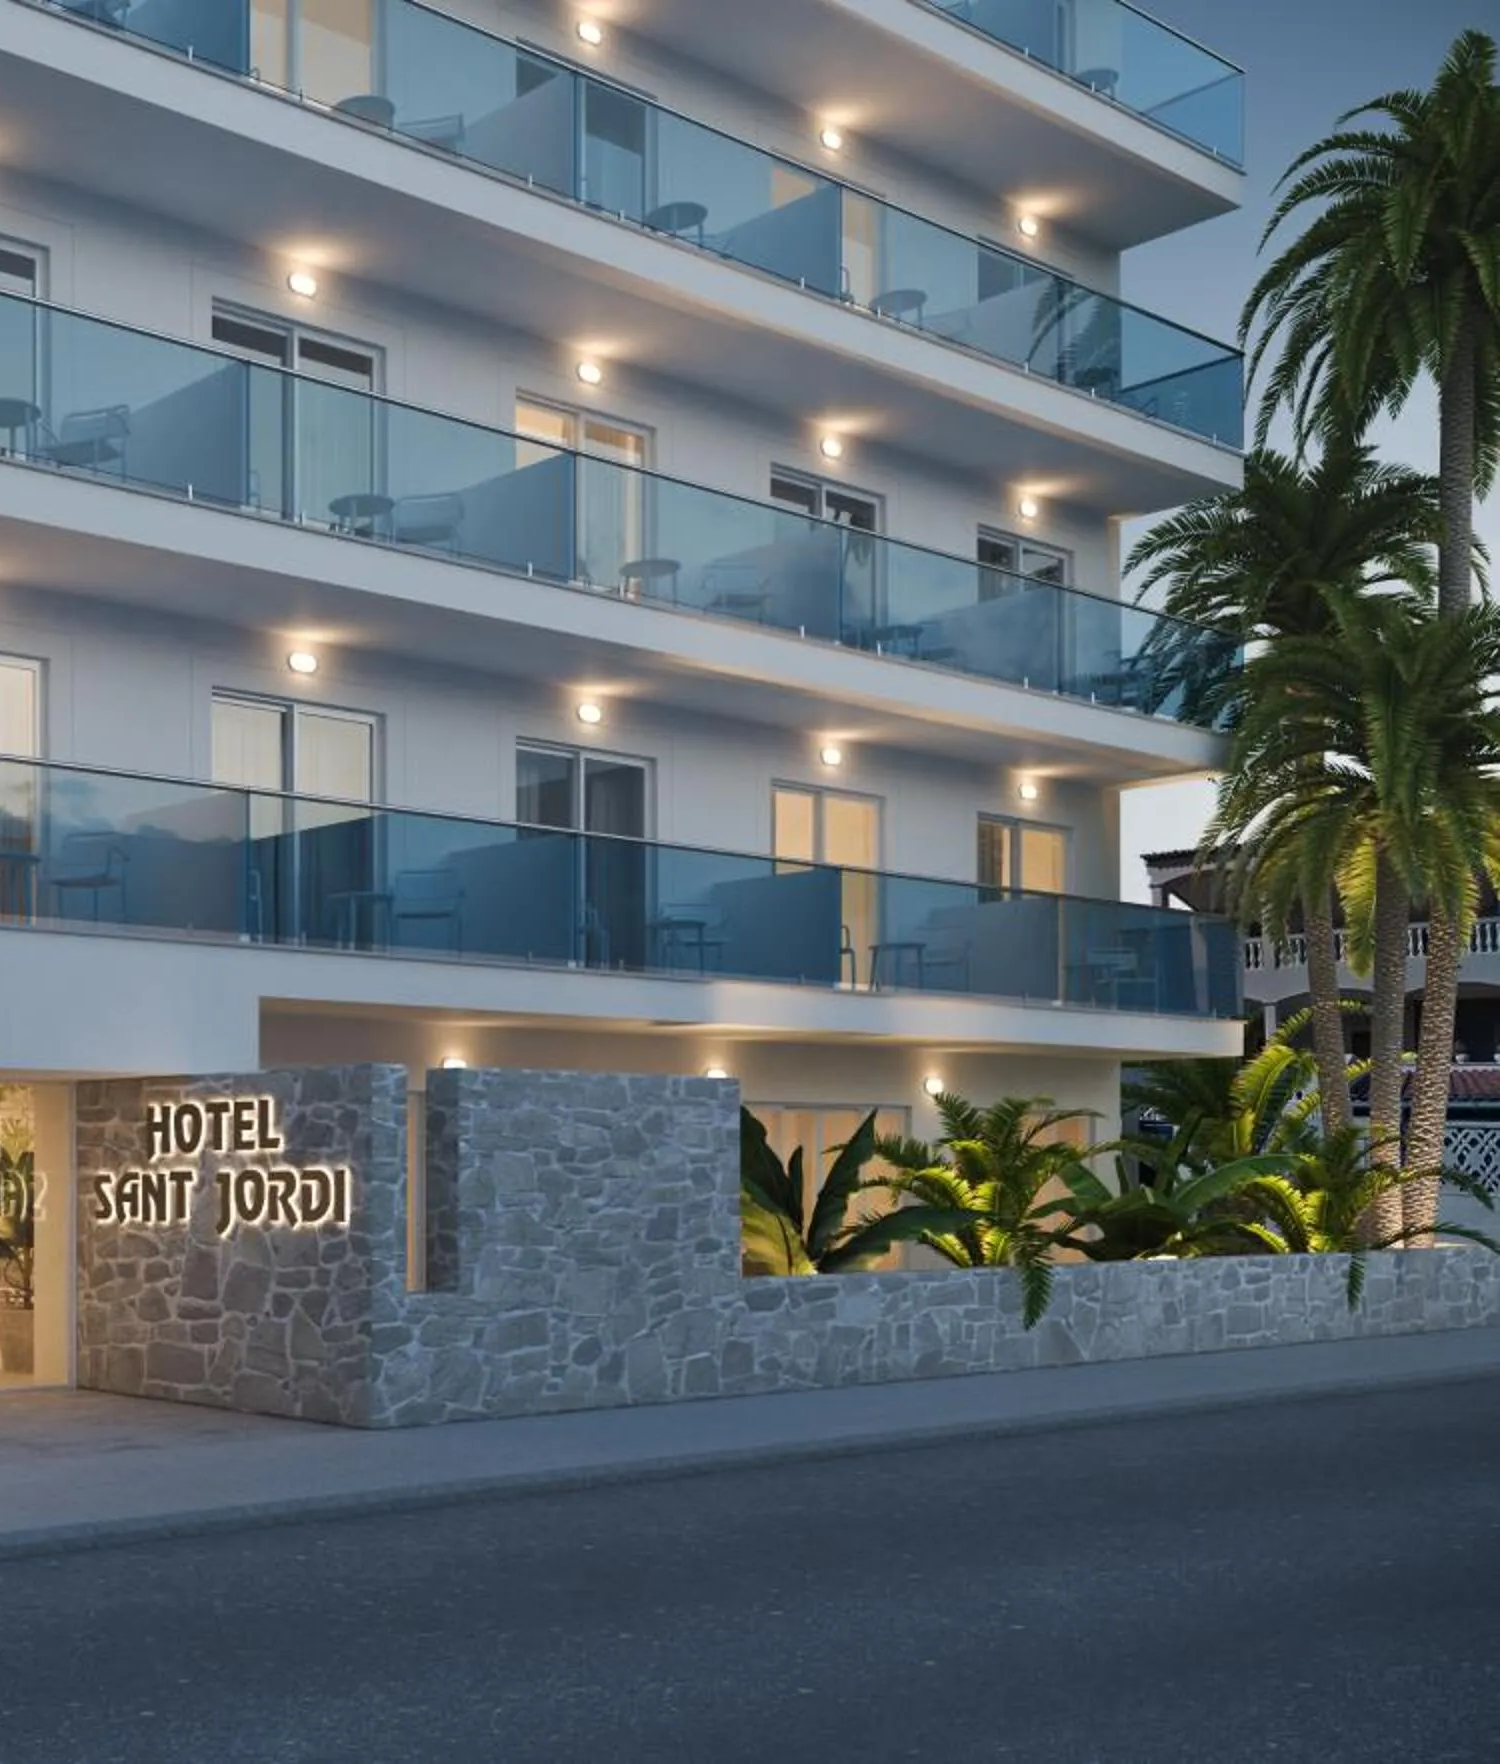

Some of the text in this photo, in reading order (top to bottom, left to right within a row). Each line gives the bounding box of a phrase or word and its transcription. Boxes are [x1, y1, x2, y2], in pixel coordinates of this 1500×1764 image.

[146, 1097, 282, 1161] HOTEL
[92, 1169, 194, 1224] SANT
[215, 1167, 348, 1236] JORDI
